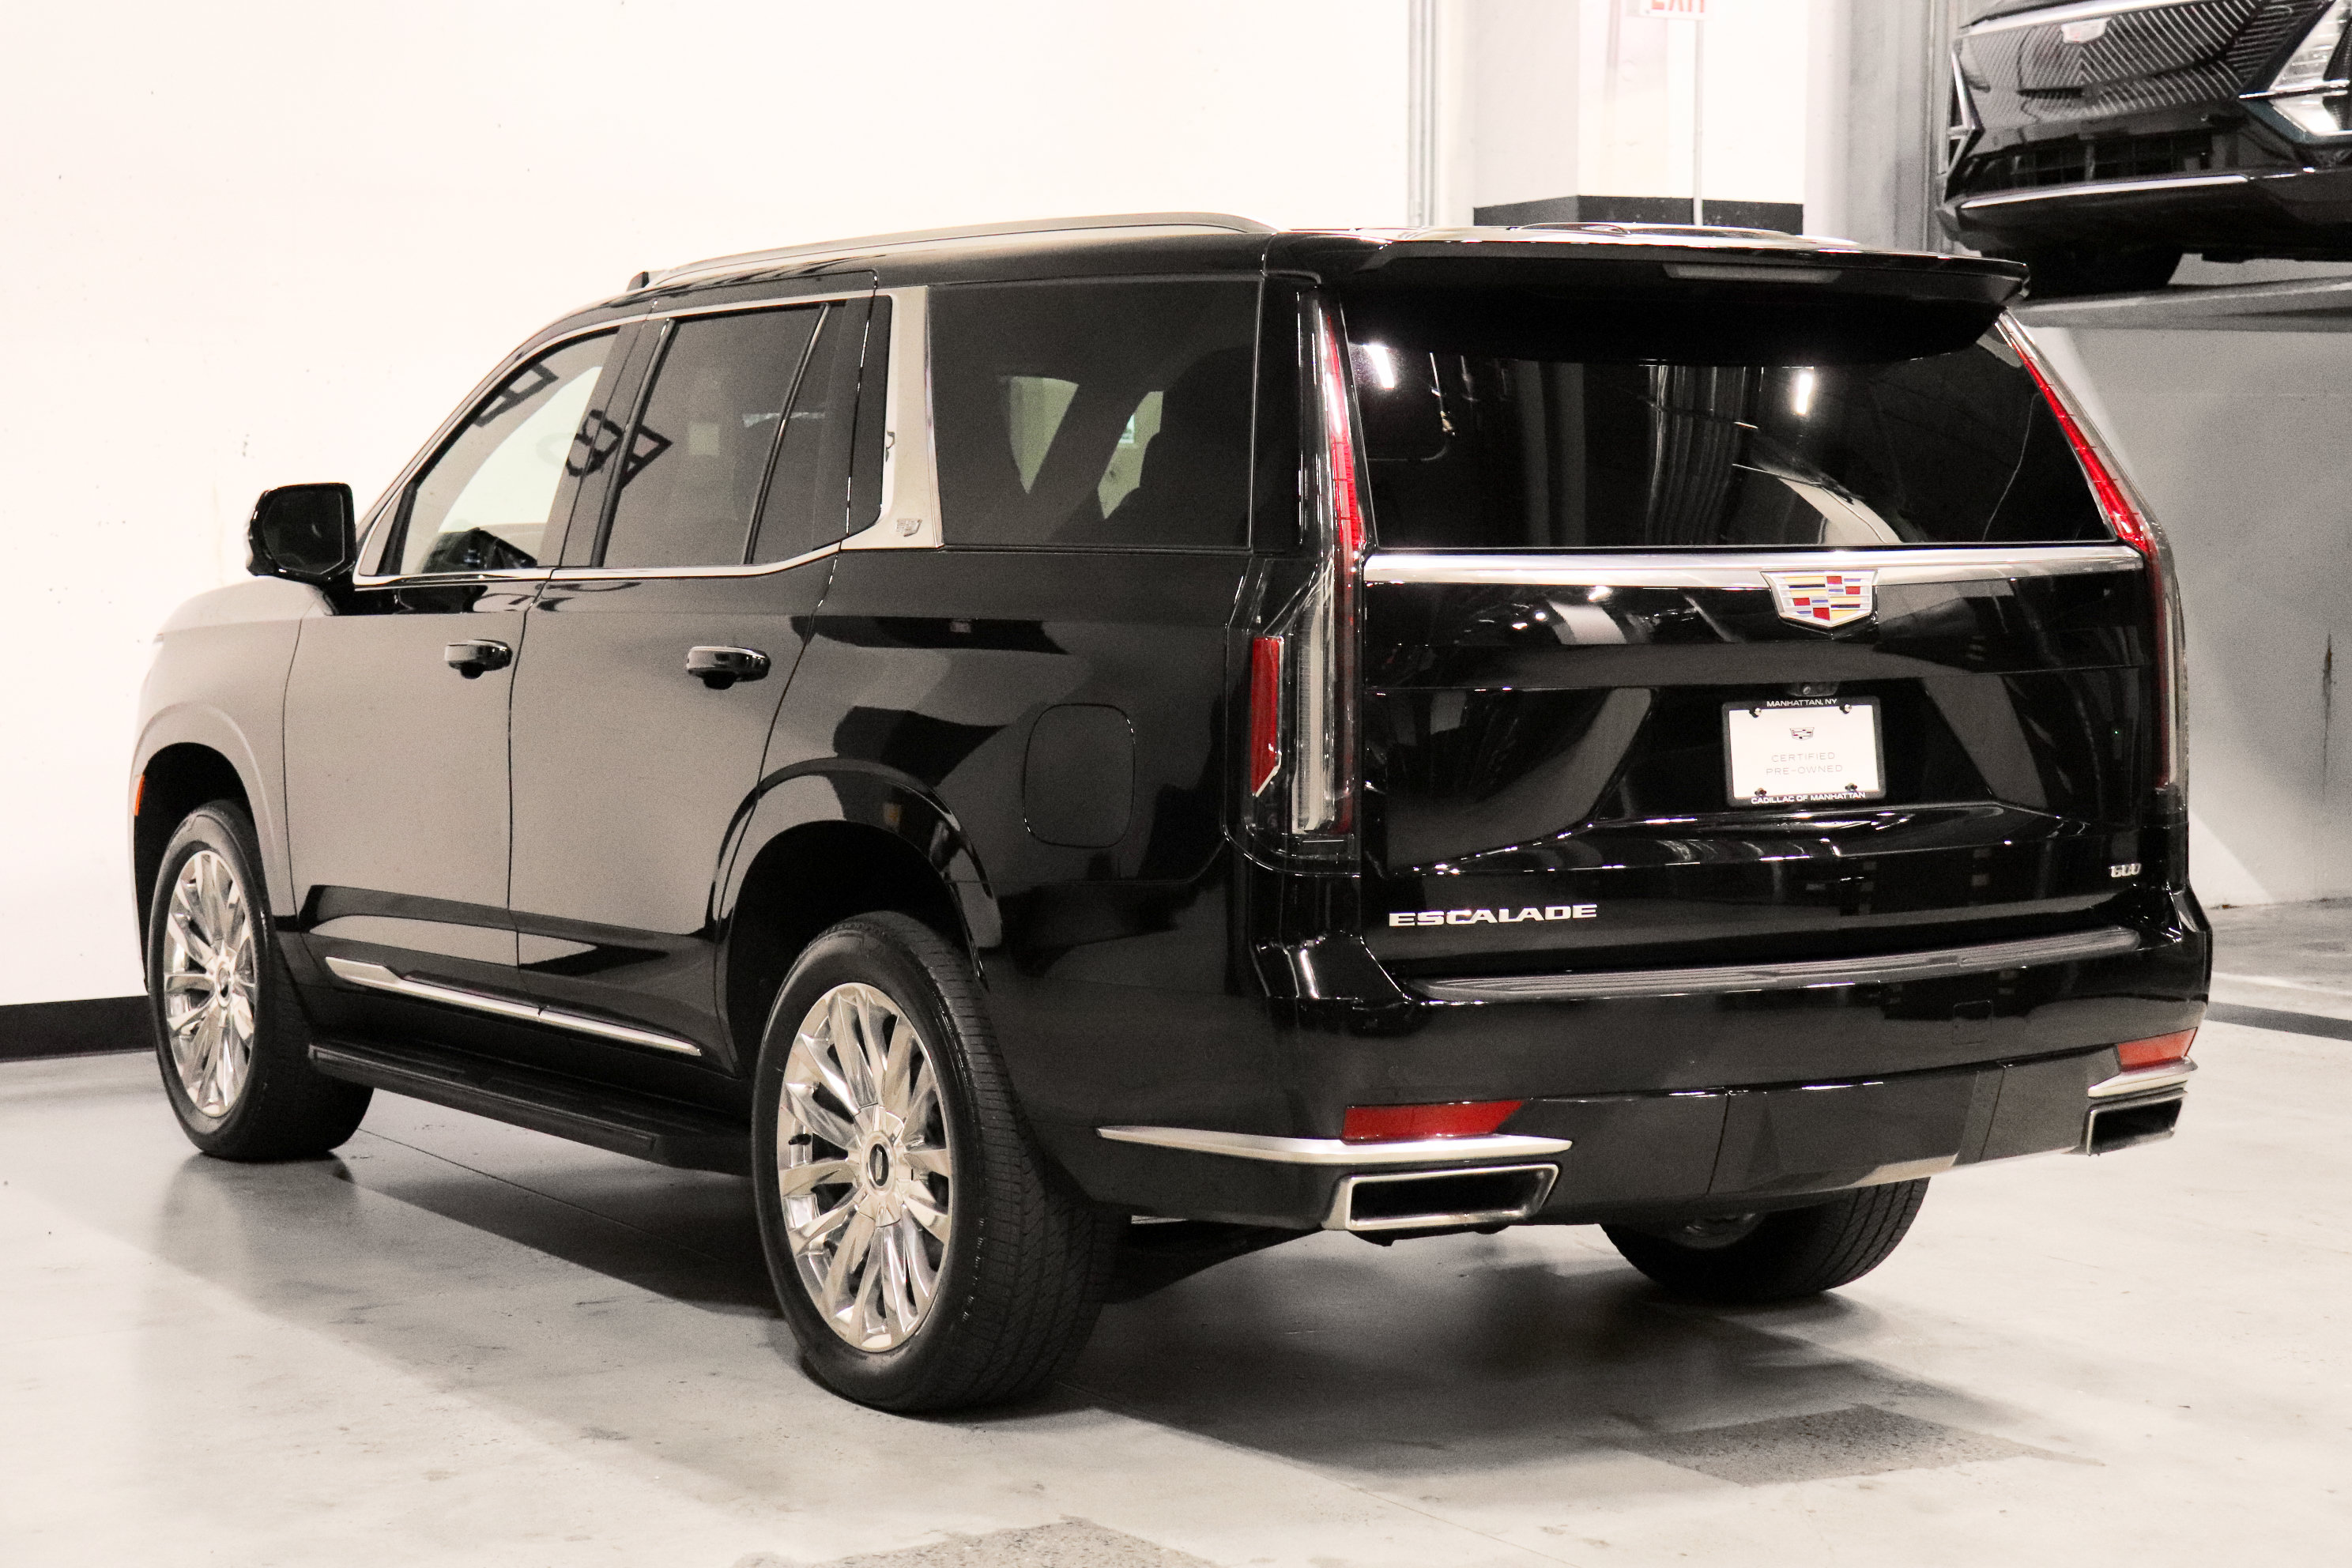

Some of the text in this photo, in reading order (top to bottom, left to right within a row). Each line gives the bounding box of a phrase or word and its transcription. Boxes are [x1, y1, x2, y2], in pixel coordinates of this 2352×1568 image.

[1766, 699, 1823, 707] MANHATTAN,
[1771, 752, 1836, 763] CERTIFIED
[1766, 764, 1843, 775] PRE-OWNED
[1751, 796, 1796, 805] CADILLAC
[1810, 792, 1867, 801] MANHATTAN
[1389, 903, 1598, 927] ESCALADE
